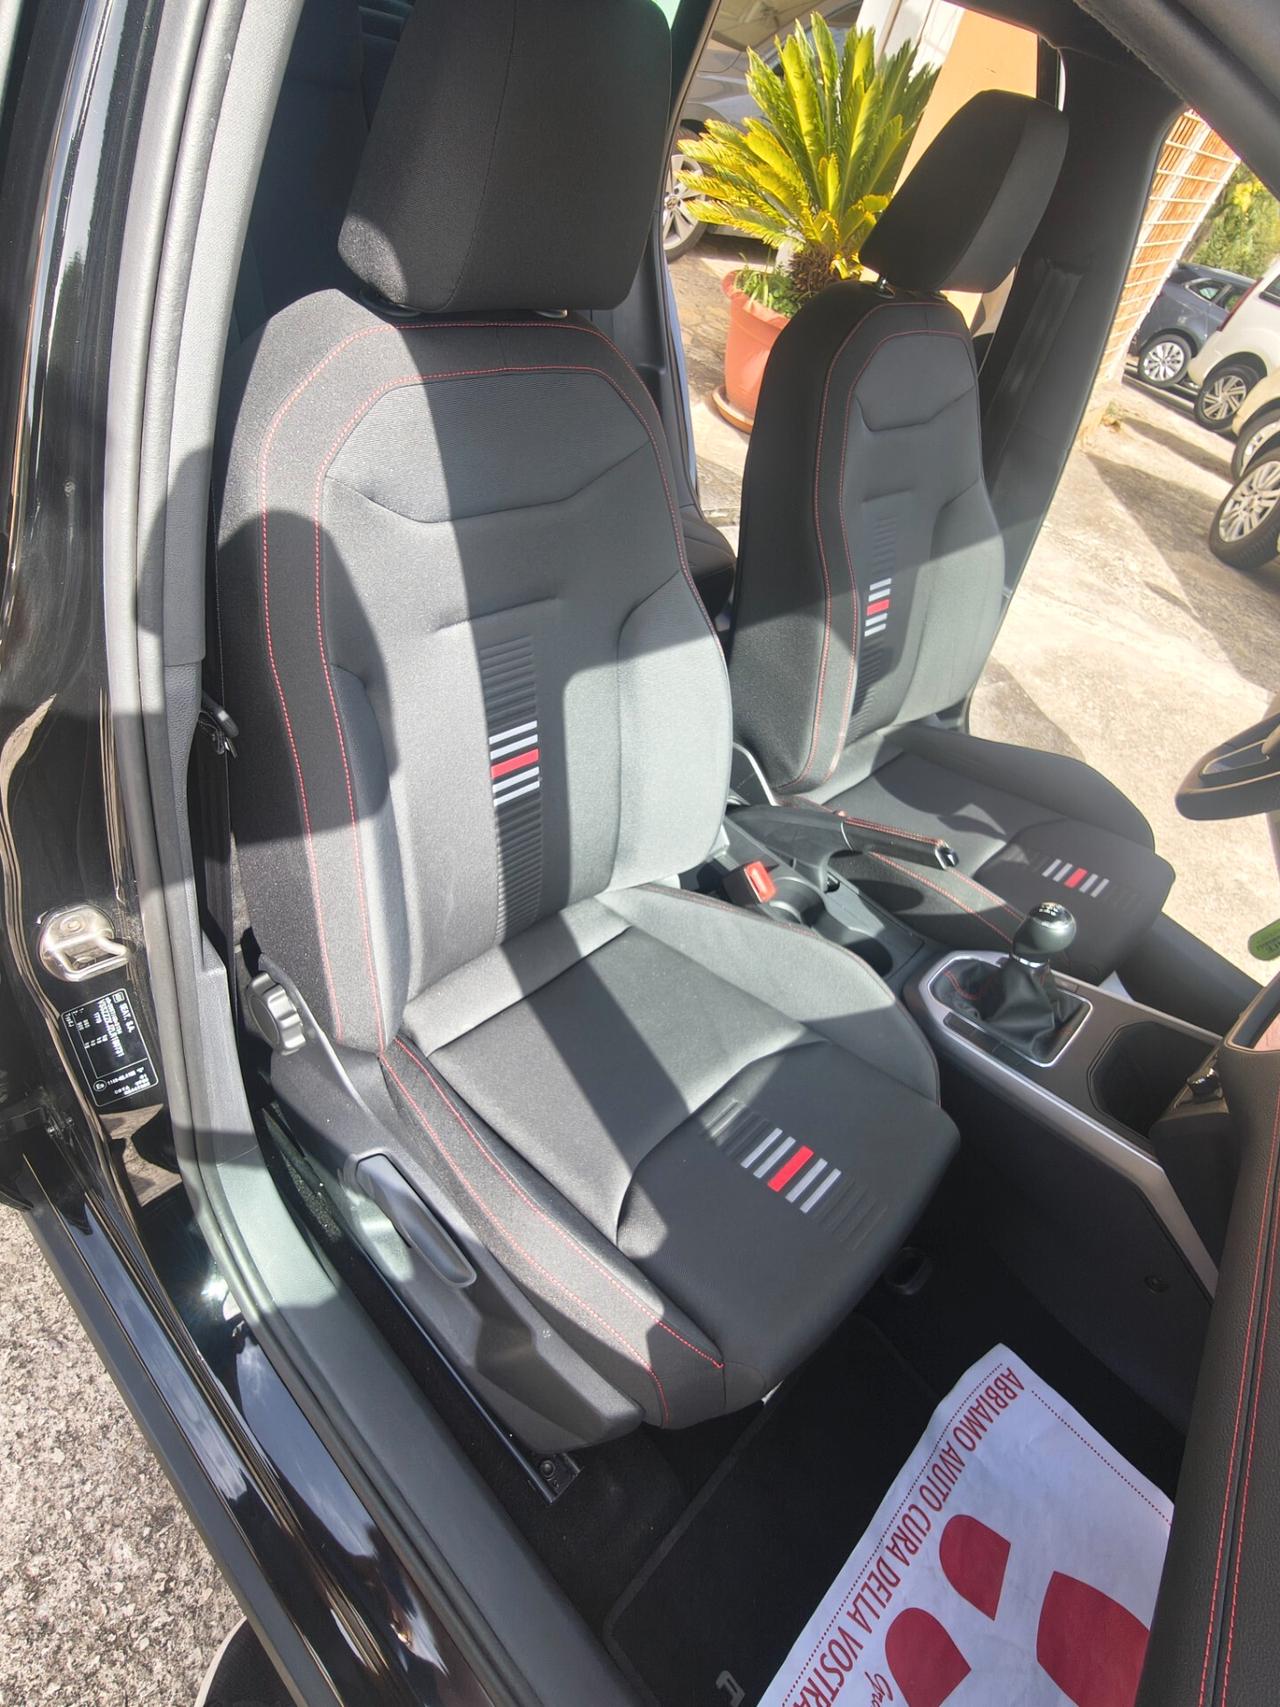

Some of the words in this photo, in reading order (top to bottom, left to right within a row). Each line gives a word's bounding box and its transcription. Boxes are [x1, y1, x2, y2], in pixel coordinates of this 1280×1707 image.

[953, 1367, 1025, 1451] ABBIAMO
[919, 1440, 966, 1512] AVUTO
[885, 1504, 932, 1567] CURA
[846, 1556, 901, 1634] DELLA
